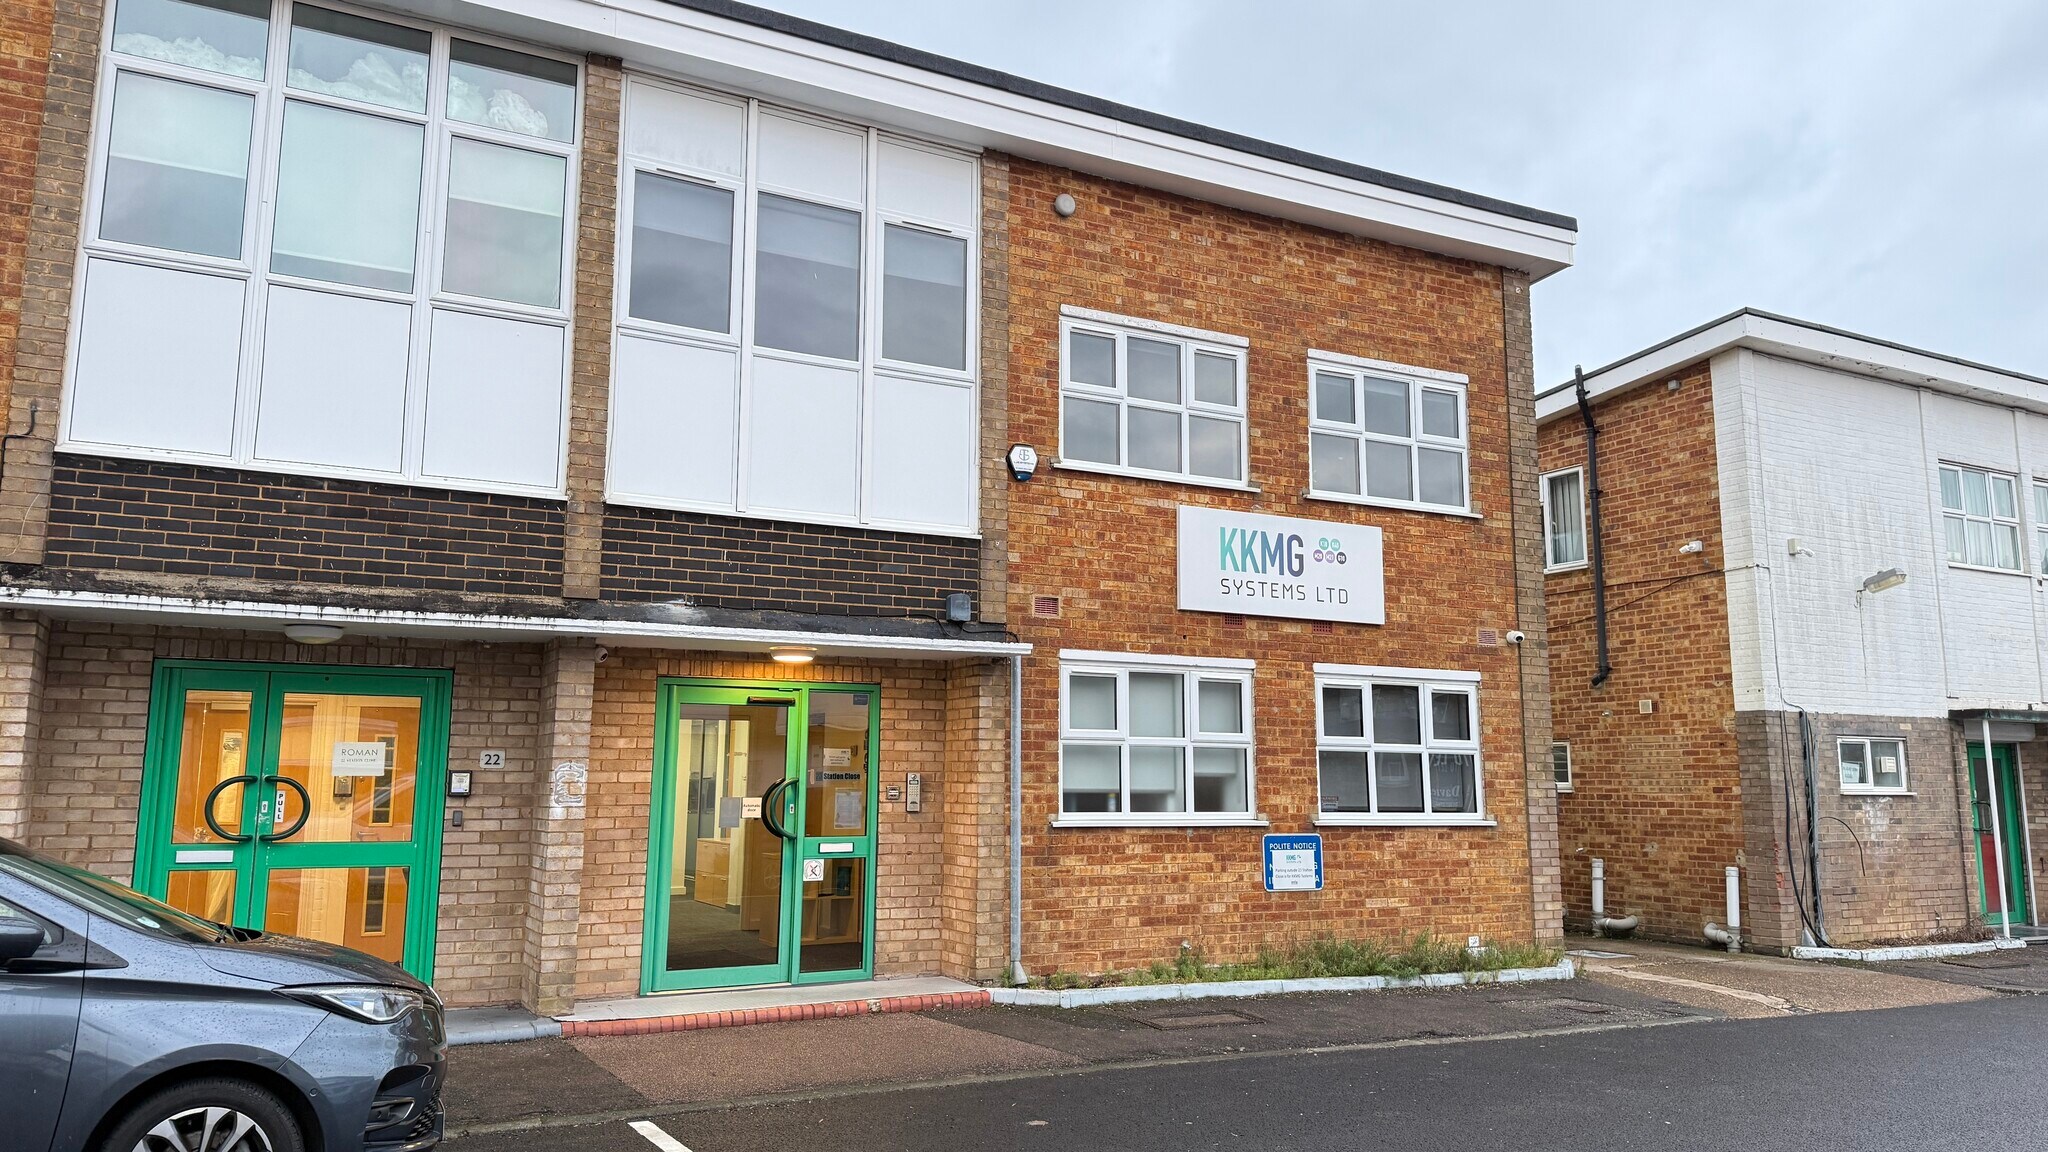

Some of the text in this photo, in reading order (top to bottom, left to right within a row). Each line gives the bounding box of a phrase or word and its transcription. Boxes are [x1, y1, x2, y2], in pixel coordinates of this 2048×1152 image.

[1220, 526, 1304, 577] KKMG
[1220, 578, 1348, 604] SYSTEMS LTD
[341, 748, 379, 756] ROMAN
[484, 754, 500, 766] 22
[823, 772, 844, 780] Station
[845, 772, 861, 780] Close
